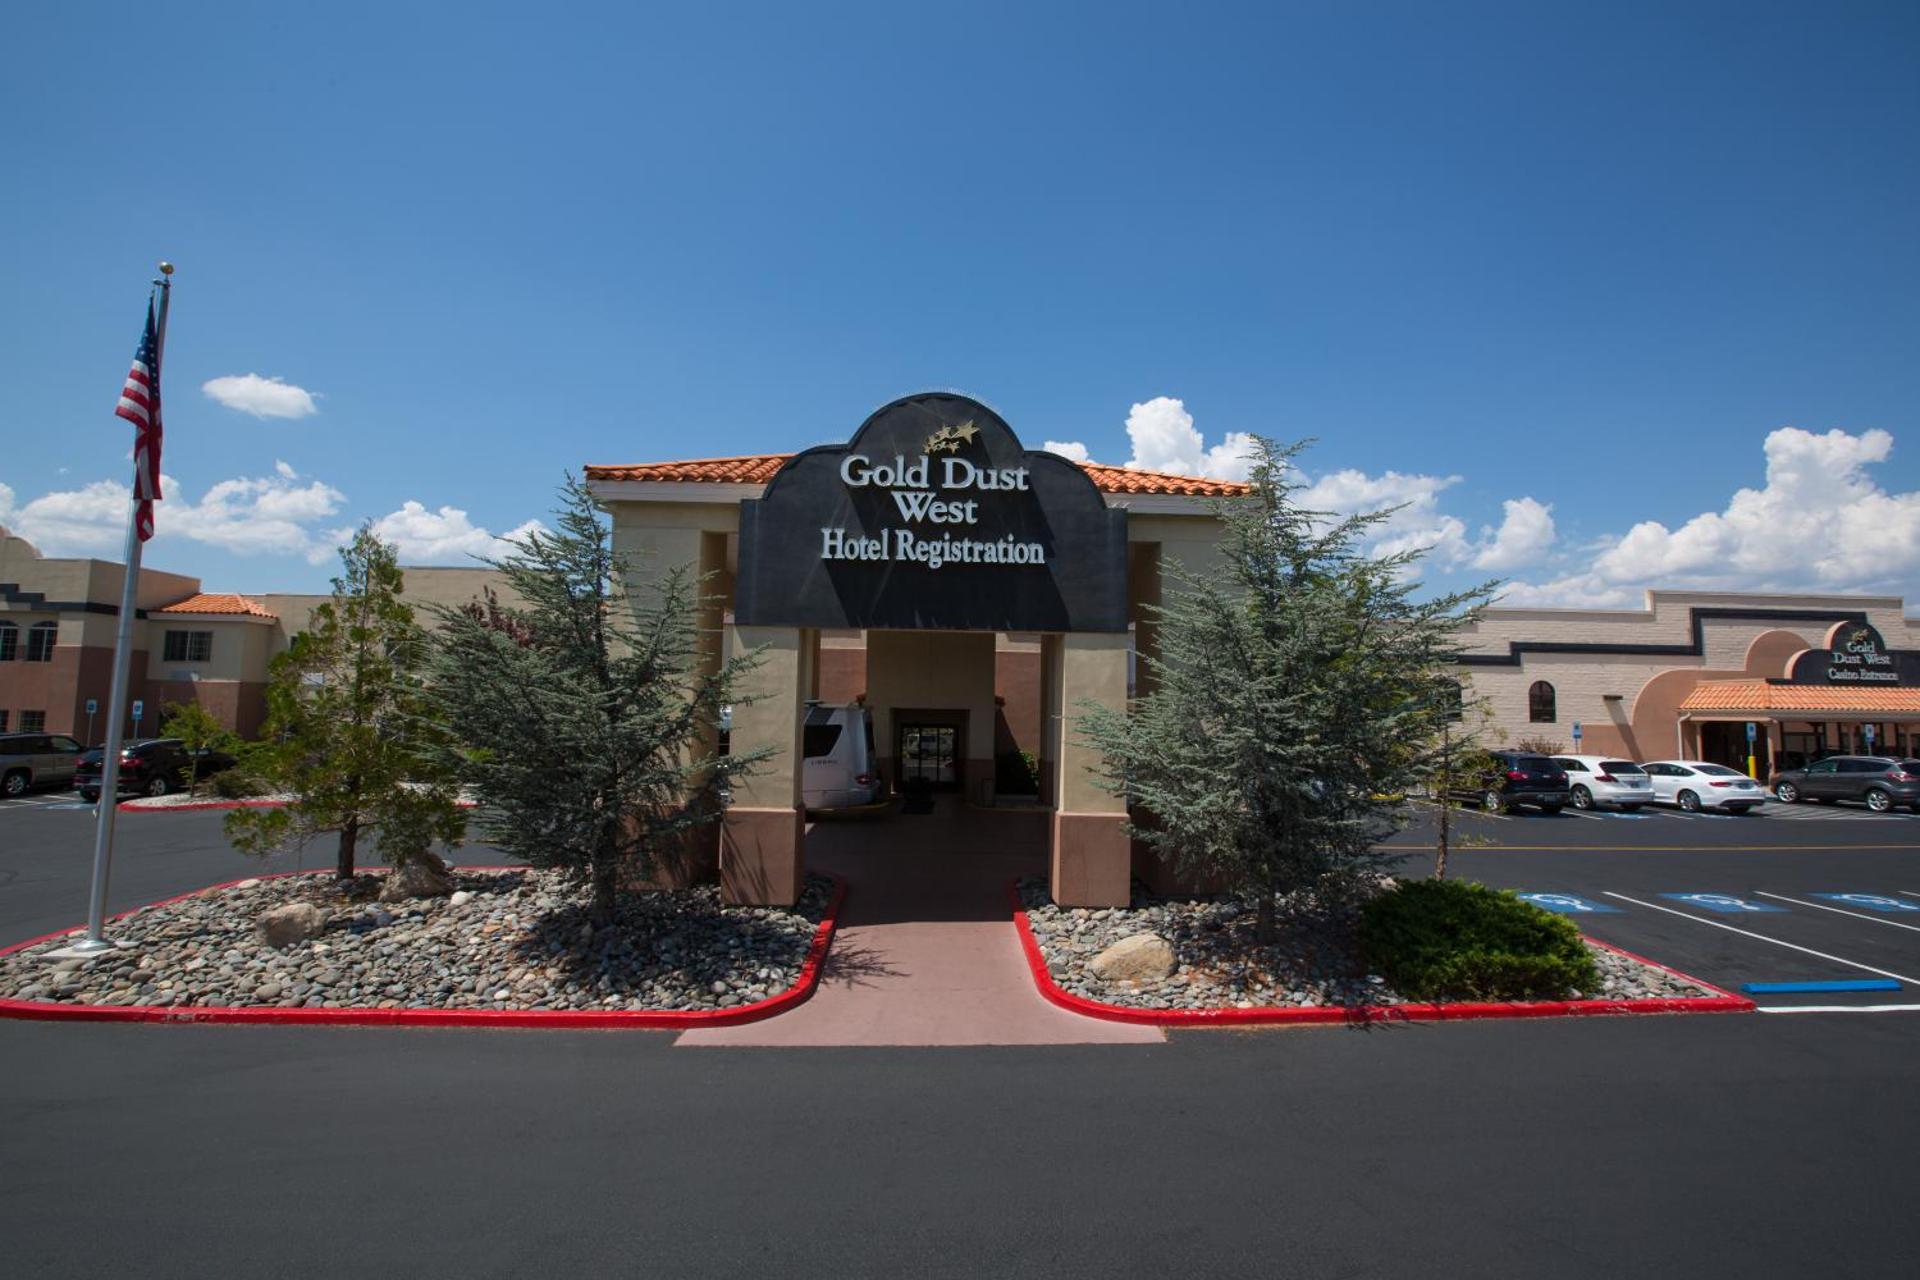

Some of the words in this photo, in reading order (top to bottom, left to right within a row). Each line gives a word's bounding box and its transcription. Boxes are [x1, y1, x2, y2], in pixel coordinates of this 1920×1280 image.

[840, 455, 930, 488] Gold
[942, 457, 1030, 491] Dust
[891, 491, 979, 524] West
[820, 528, 889, 561] Hotel
[895, 529, 1045, 569] Registration
[1846, 641, 1875, 653] Gold
[1833, 653, 1861, 664] Dust
[1864, 653, 1891, 665] West
[1828, 668, 1857, 680] Casino
[1859, 669, 1899, 681] Entrance
